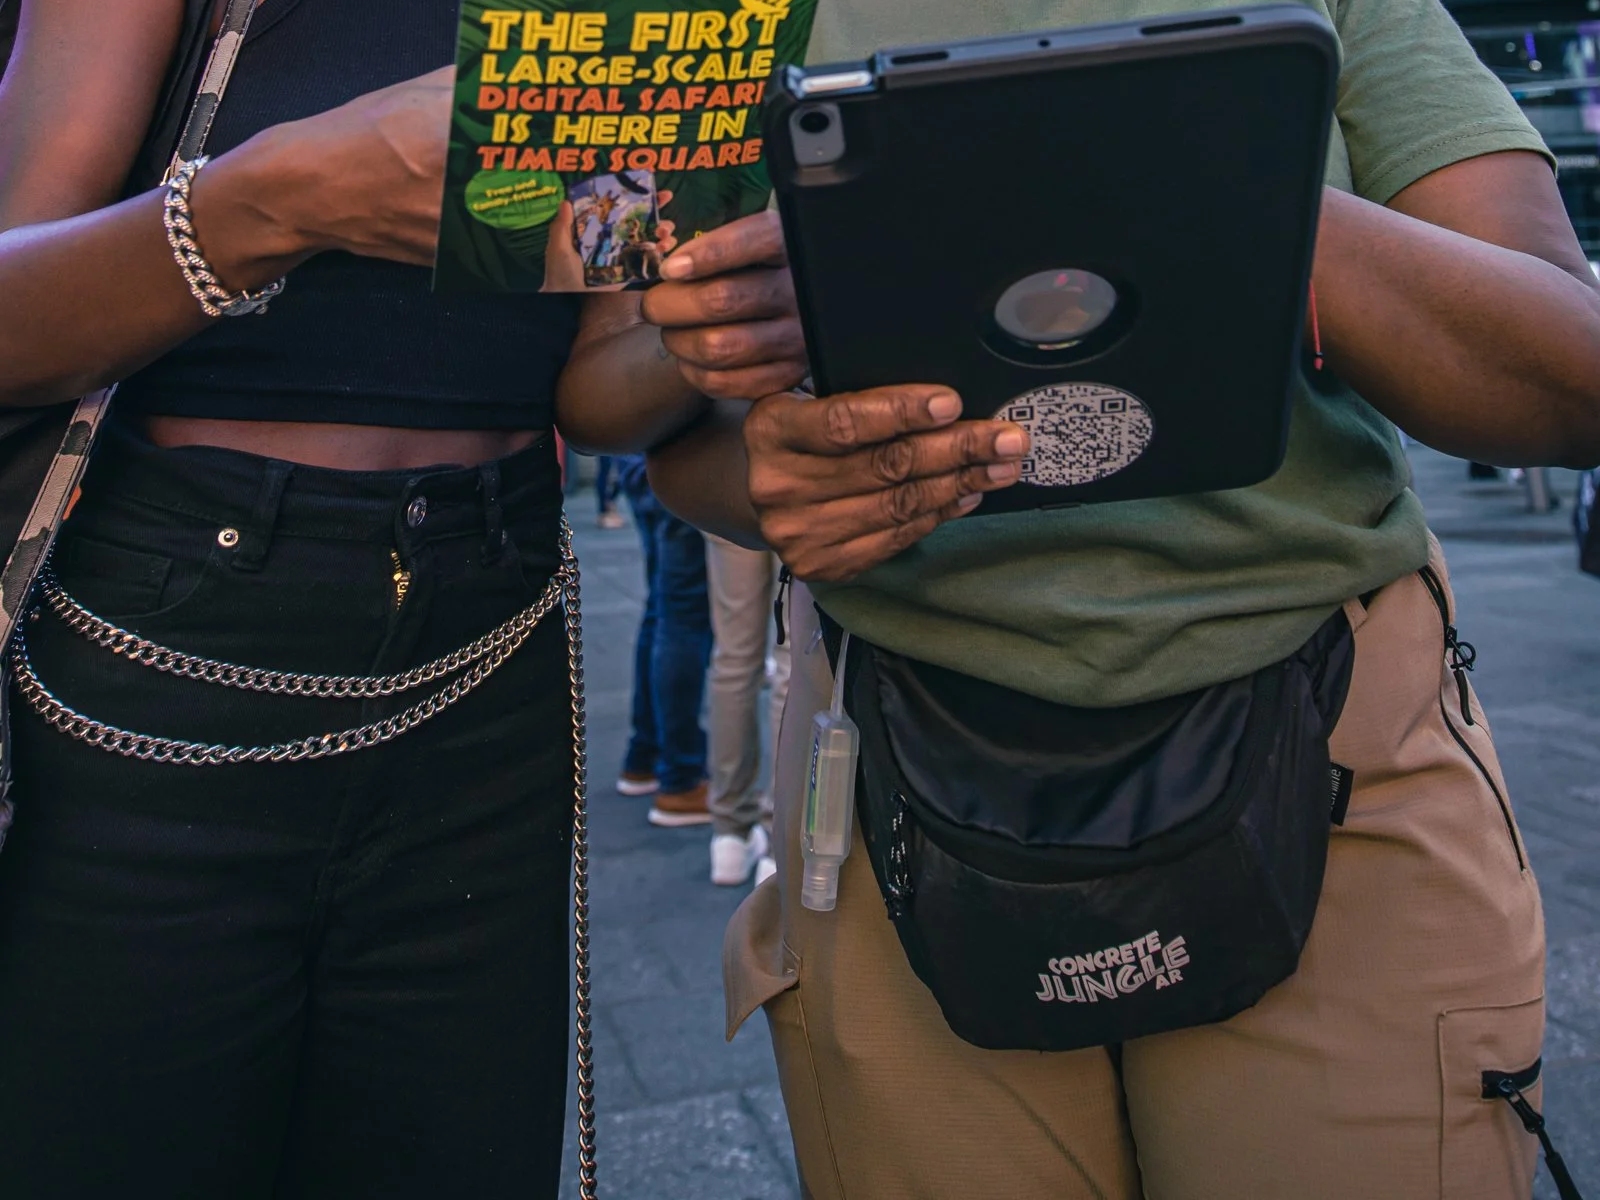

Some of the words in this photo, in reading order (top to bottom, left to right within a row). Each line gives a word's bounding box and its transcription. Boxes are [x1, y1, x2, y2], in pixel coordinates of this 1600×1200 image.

[480, 10, 607, 52] THE
[630, 6, 790, 52] FIRST
[480, 49, 775, 85] LARGE-SCALE
[478, 85, 625, 112] DIGITAL
[639, 81, 766, 111] SAFARI
[492, 113, 533, 144] IS
[553, 113, 681, 145] HERE
[697, 108, 748, 142] IN
[477, 146, 598, 172] TIMES
[609, 138, 763, 172] SQUARE
[1035, 935, 1190, 1003] JUNGLE
[1048, 930, 1161, 976] CONCRETE
[1155, 968, 1183, 990] AR
